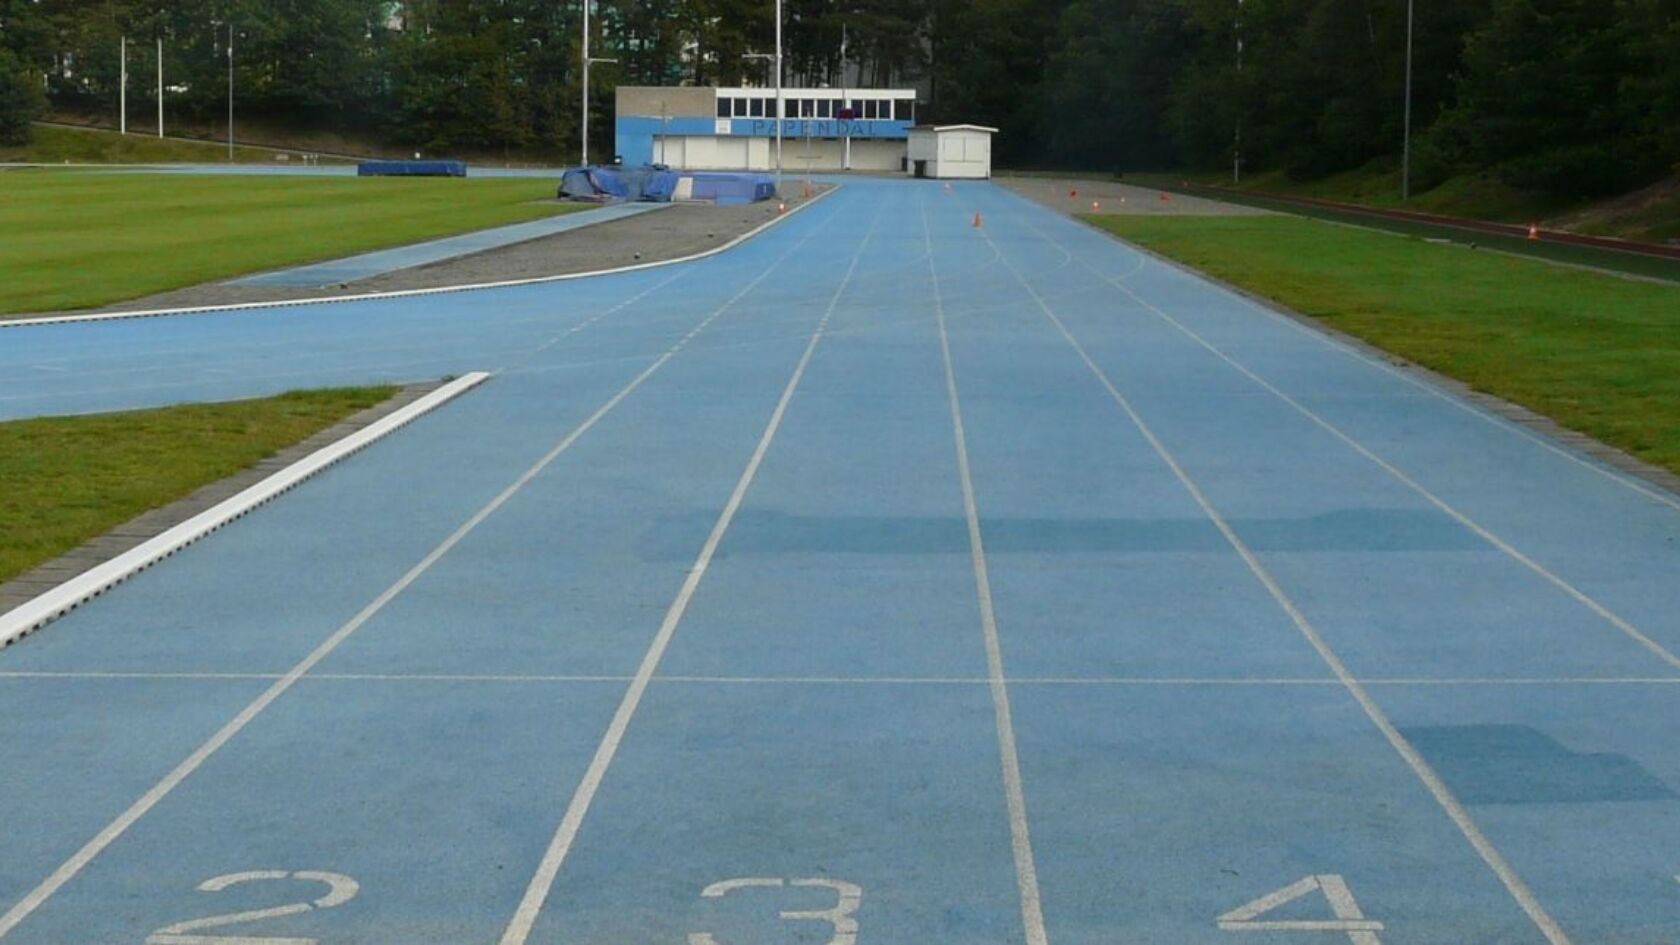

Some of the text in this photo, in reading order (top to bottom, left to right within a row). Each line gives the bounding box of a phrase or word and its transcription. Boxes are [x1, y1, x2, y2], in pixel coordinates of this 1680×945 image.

[752, 119, 876, 136] PAPENDAL
[145, 870, 360, 945] 2
[687, 878, 862, 945] 3
[1216, 874, 1384, 945] 4
